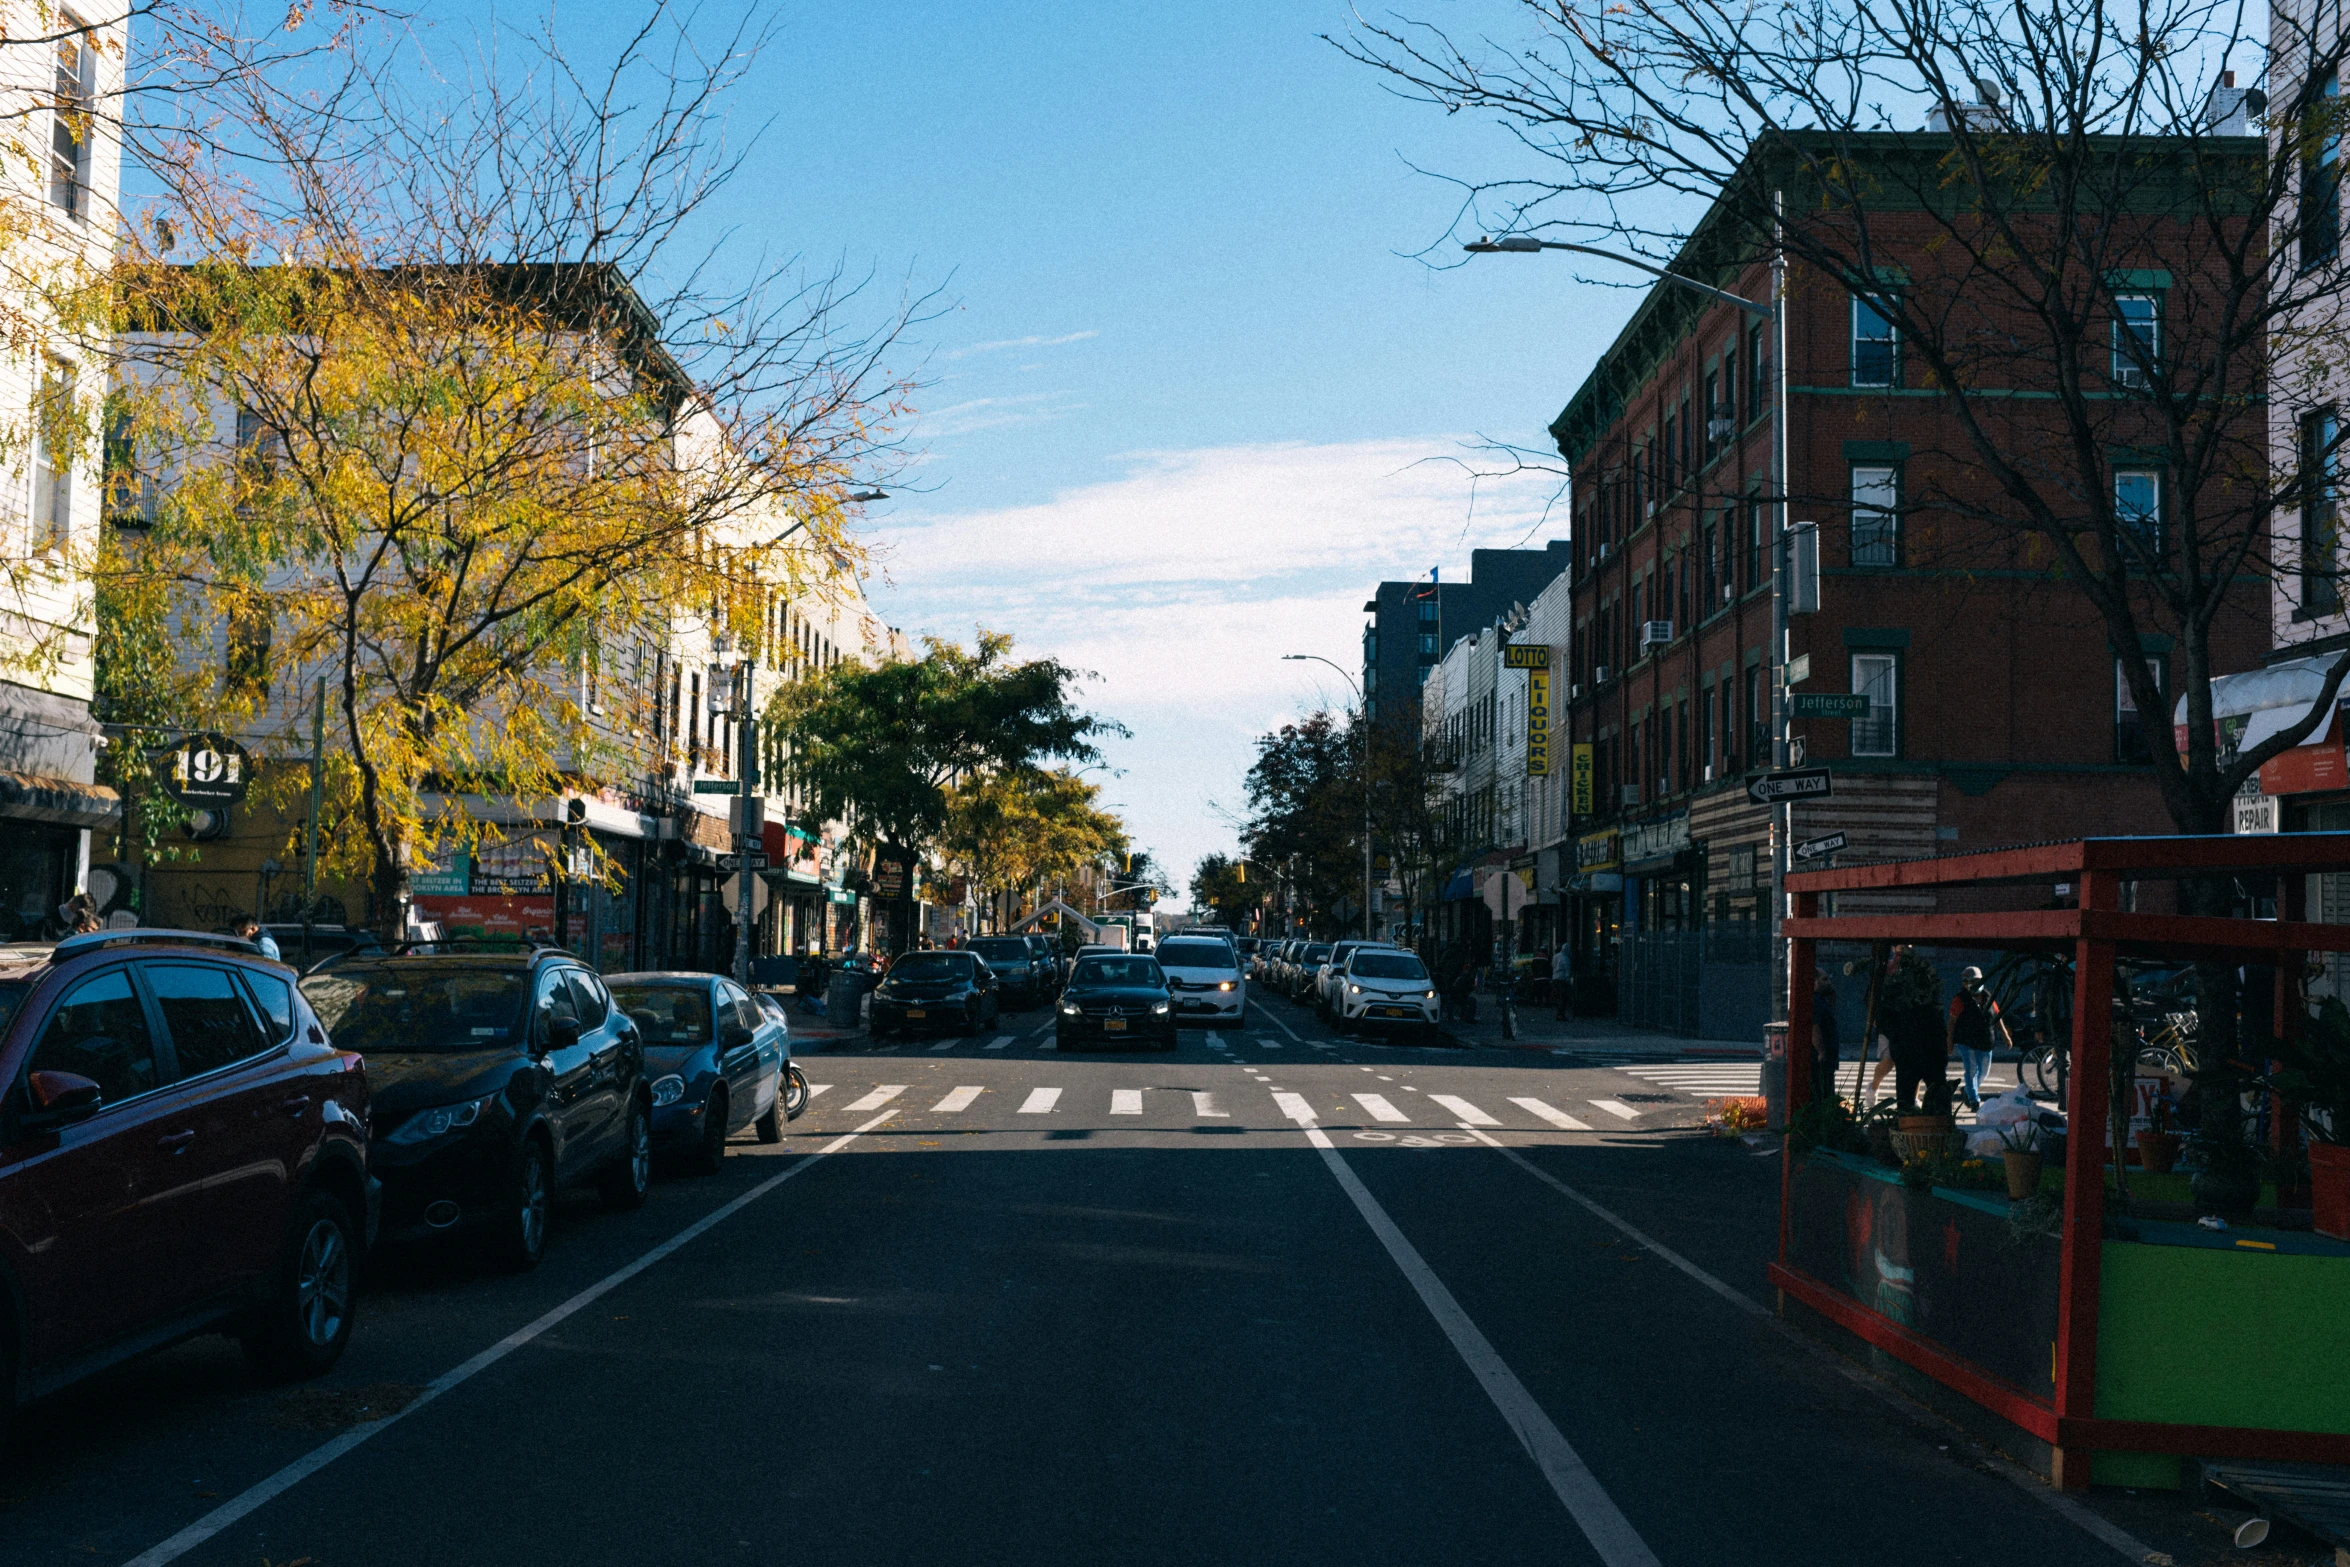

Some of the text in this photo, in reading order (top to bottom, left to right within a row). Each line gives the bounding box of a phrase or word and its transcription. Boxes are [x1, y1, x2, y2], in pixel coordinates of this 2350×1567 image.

[1508, 648, 1547, 665] LOTTO
[1801, 696, 1863, 709] Jefferson
[1531, 680, 1547, 771] LIQUORS
[176, 749, 240, 784] 191
[700, 781, 737, 790] Jefferson
[1576, 754, 1590, 812] CHICKEN
[1758, 778, 1821, 795] ONE WAY
[2239, 807, 2270, 832] REPAIR
[1801, 838, 1841, 856] ONE WAY
[723, 859, 739, 867] ONE
[421, 877, 451, 885] SELTZER
